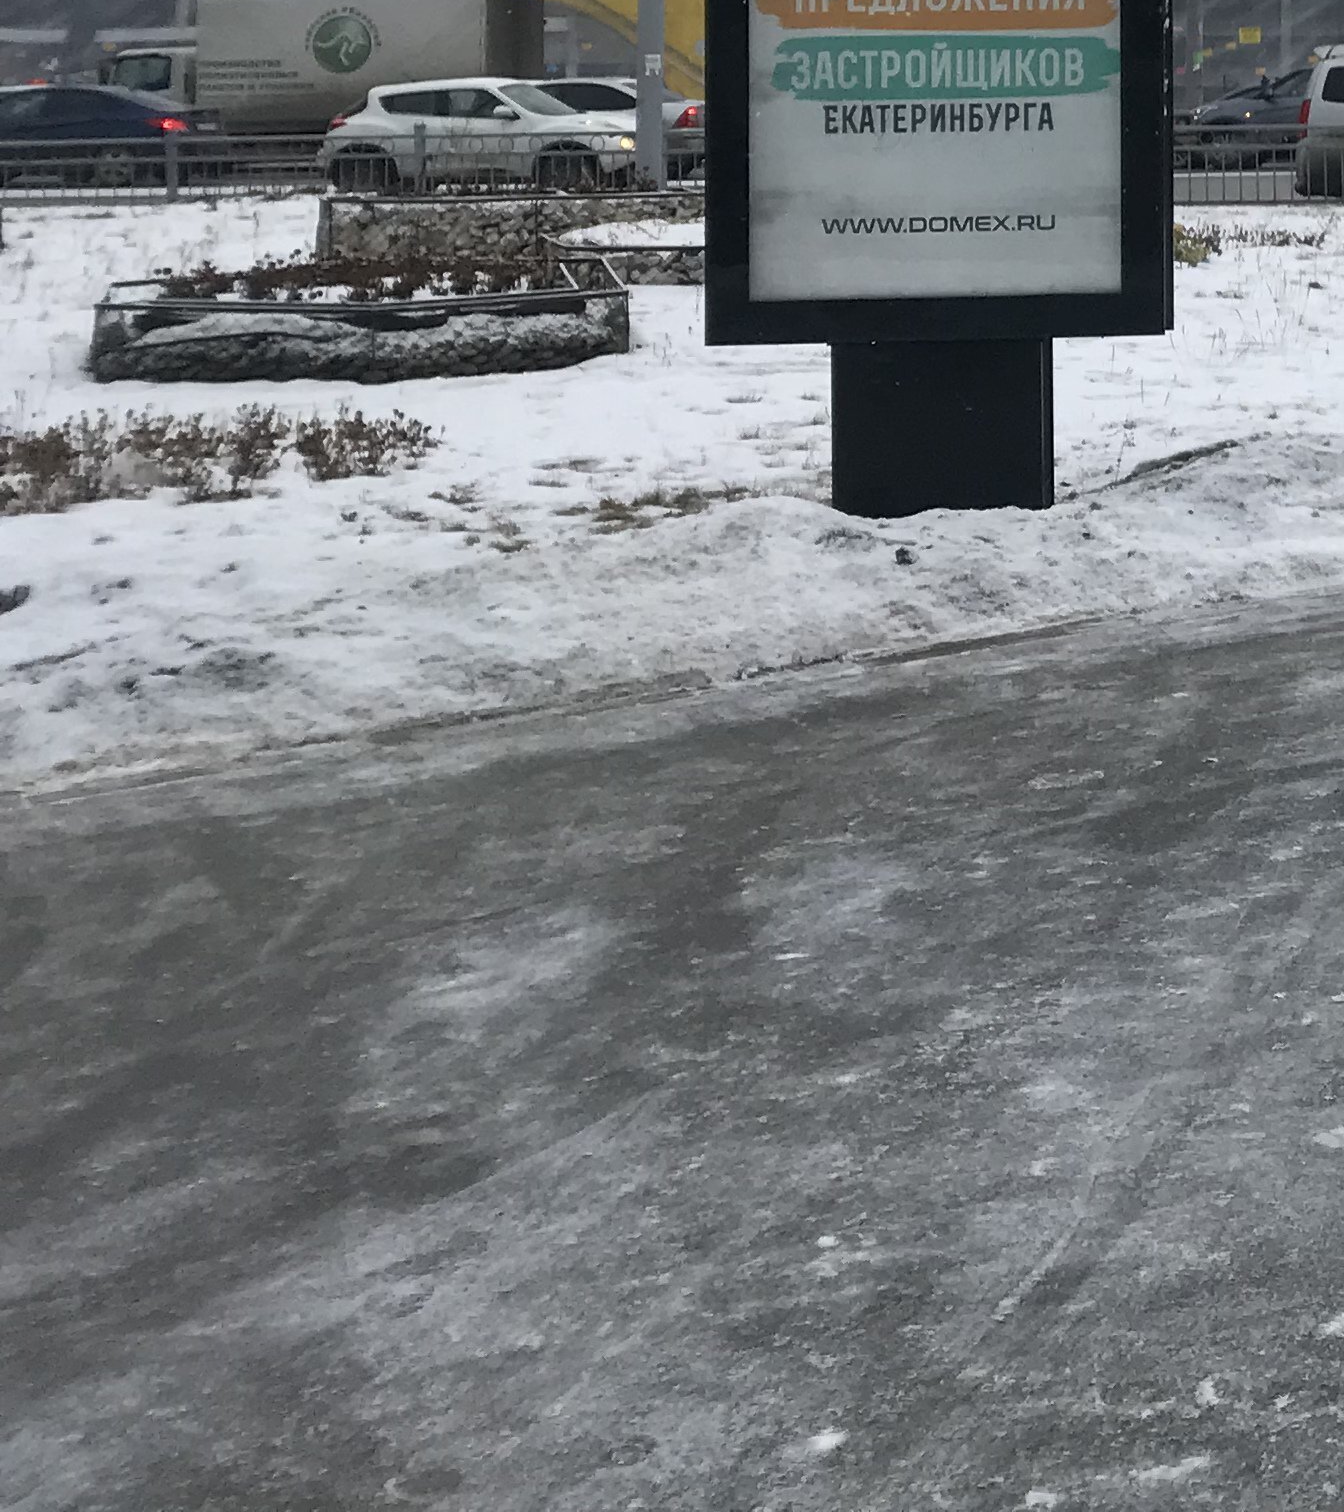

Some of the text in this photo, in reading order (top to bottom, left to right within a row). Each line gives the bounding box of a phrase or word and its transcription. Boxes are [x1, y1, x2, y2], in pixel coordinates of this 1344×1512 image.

[790, 41, 1085, 90] ЗАСТРОЙЩИКОВ
[823, 102, 1055, 135] ЕКАТЕРИНБУРГА
[821, 214, 1056, 234] WWW.DOMEX.RU
